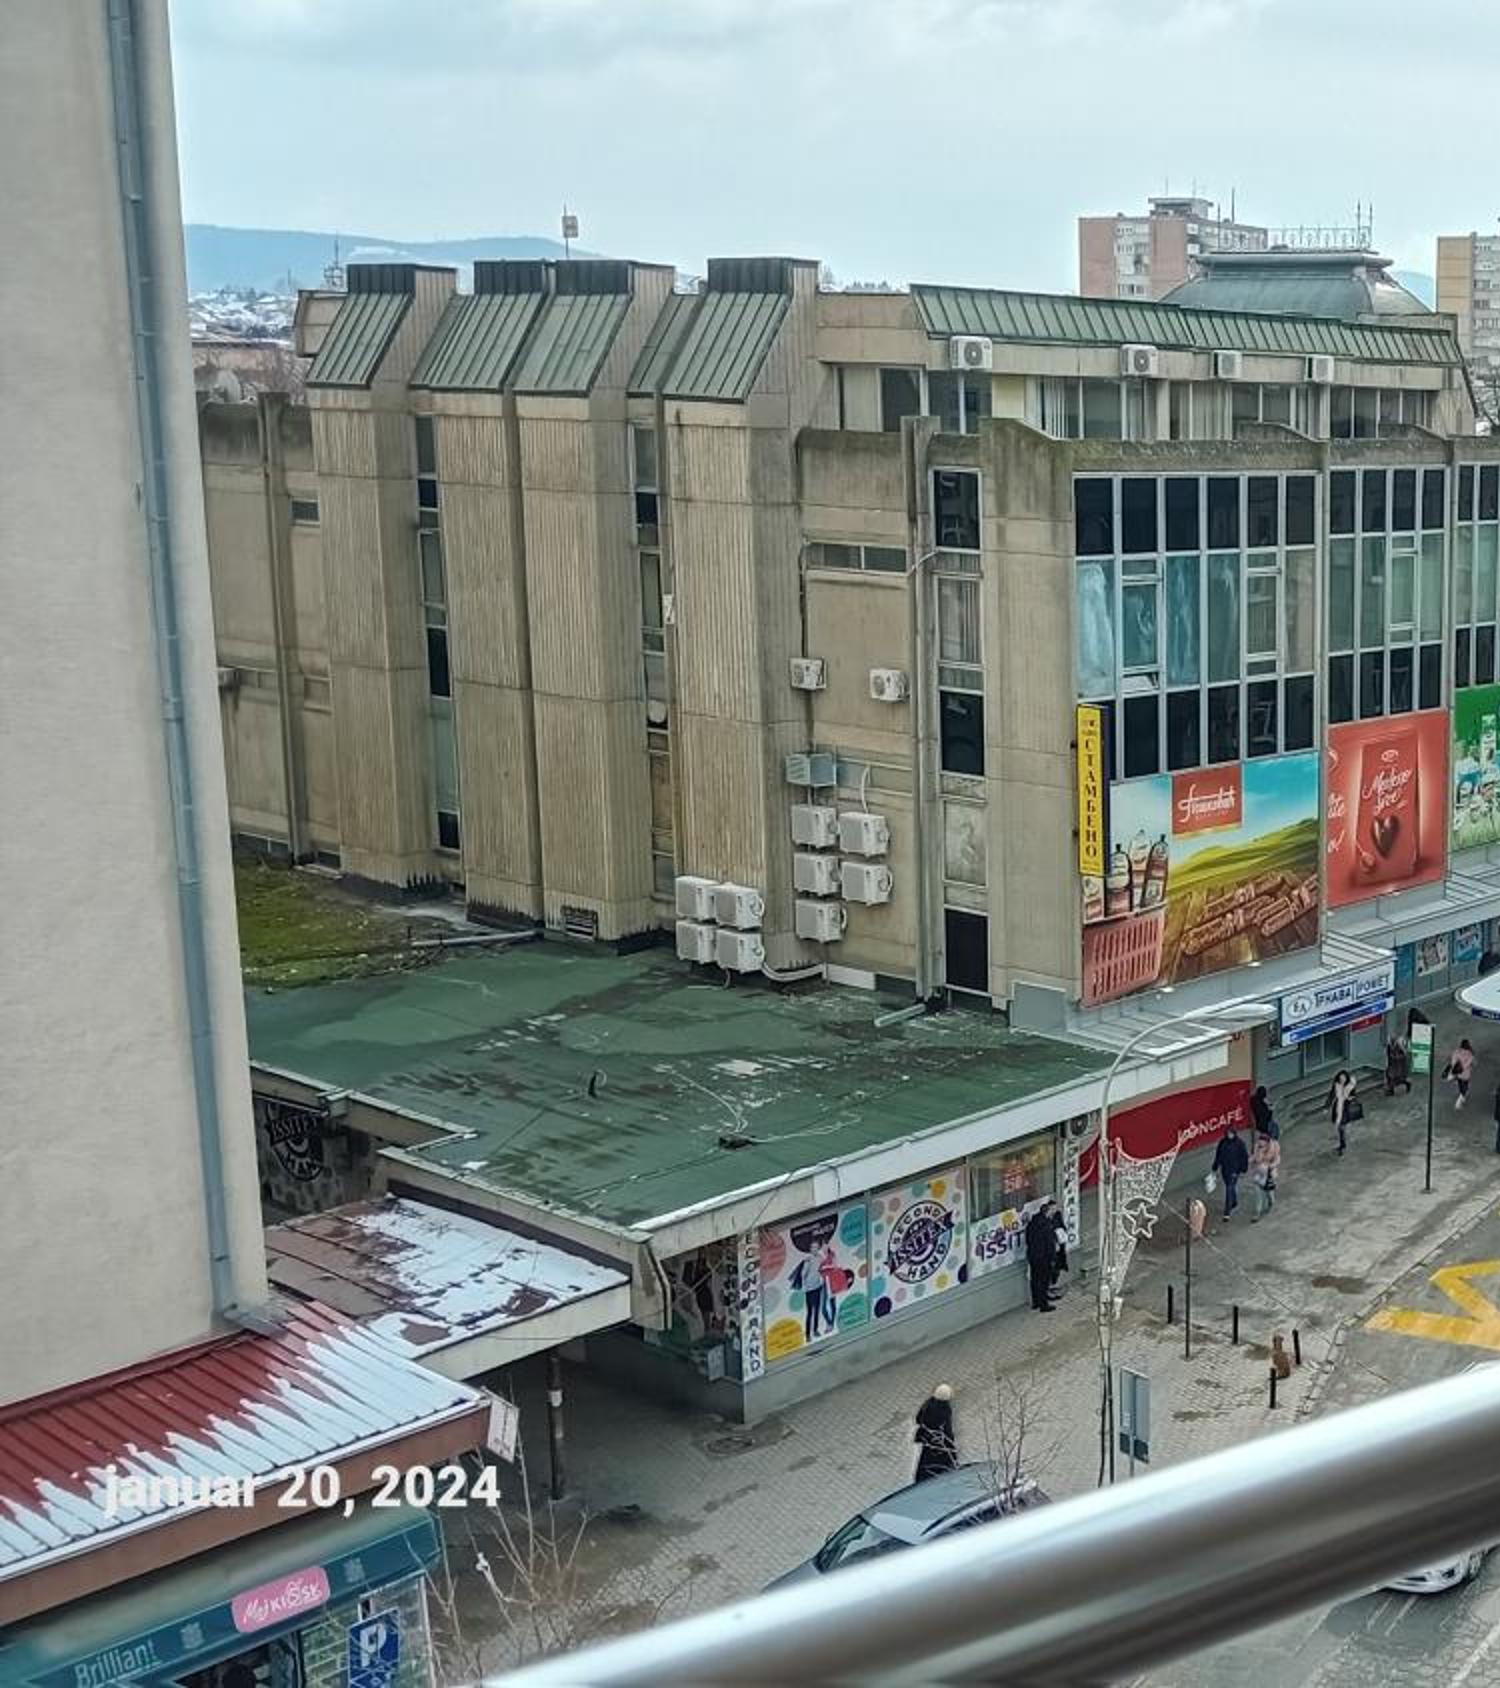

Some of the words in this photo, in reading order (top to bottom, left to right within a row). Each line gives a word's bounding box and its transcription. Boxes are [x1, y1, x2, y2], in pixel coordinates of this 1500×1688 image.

[907, 1243, 947, 1279] HAND
[74, 1639, 158, 1688] Brilliant
[360, 1622, 387, 1668] P
